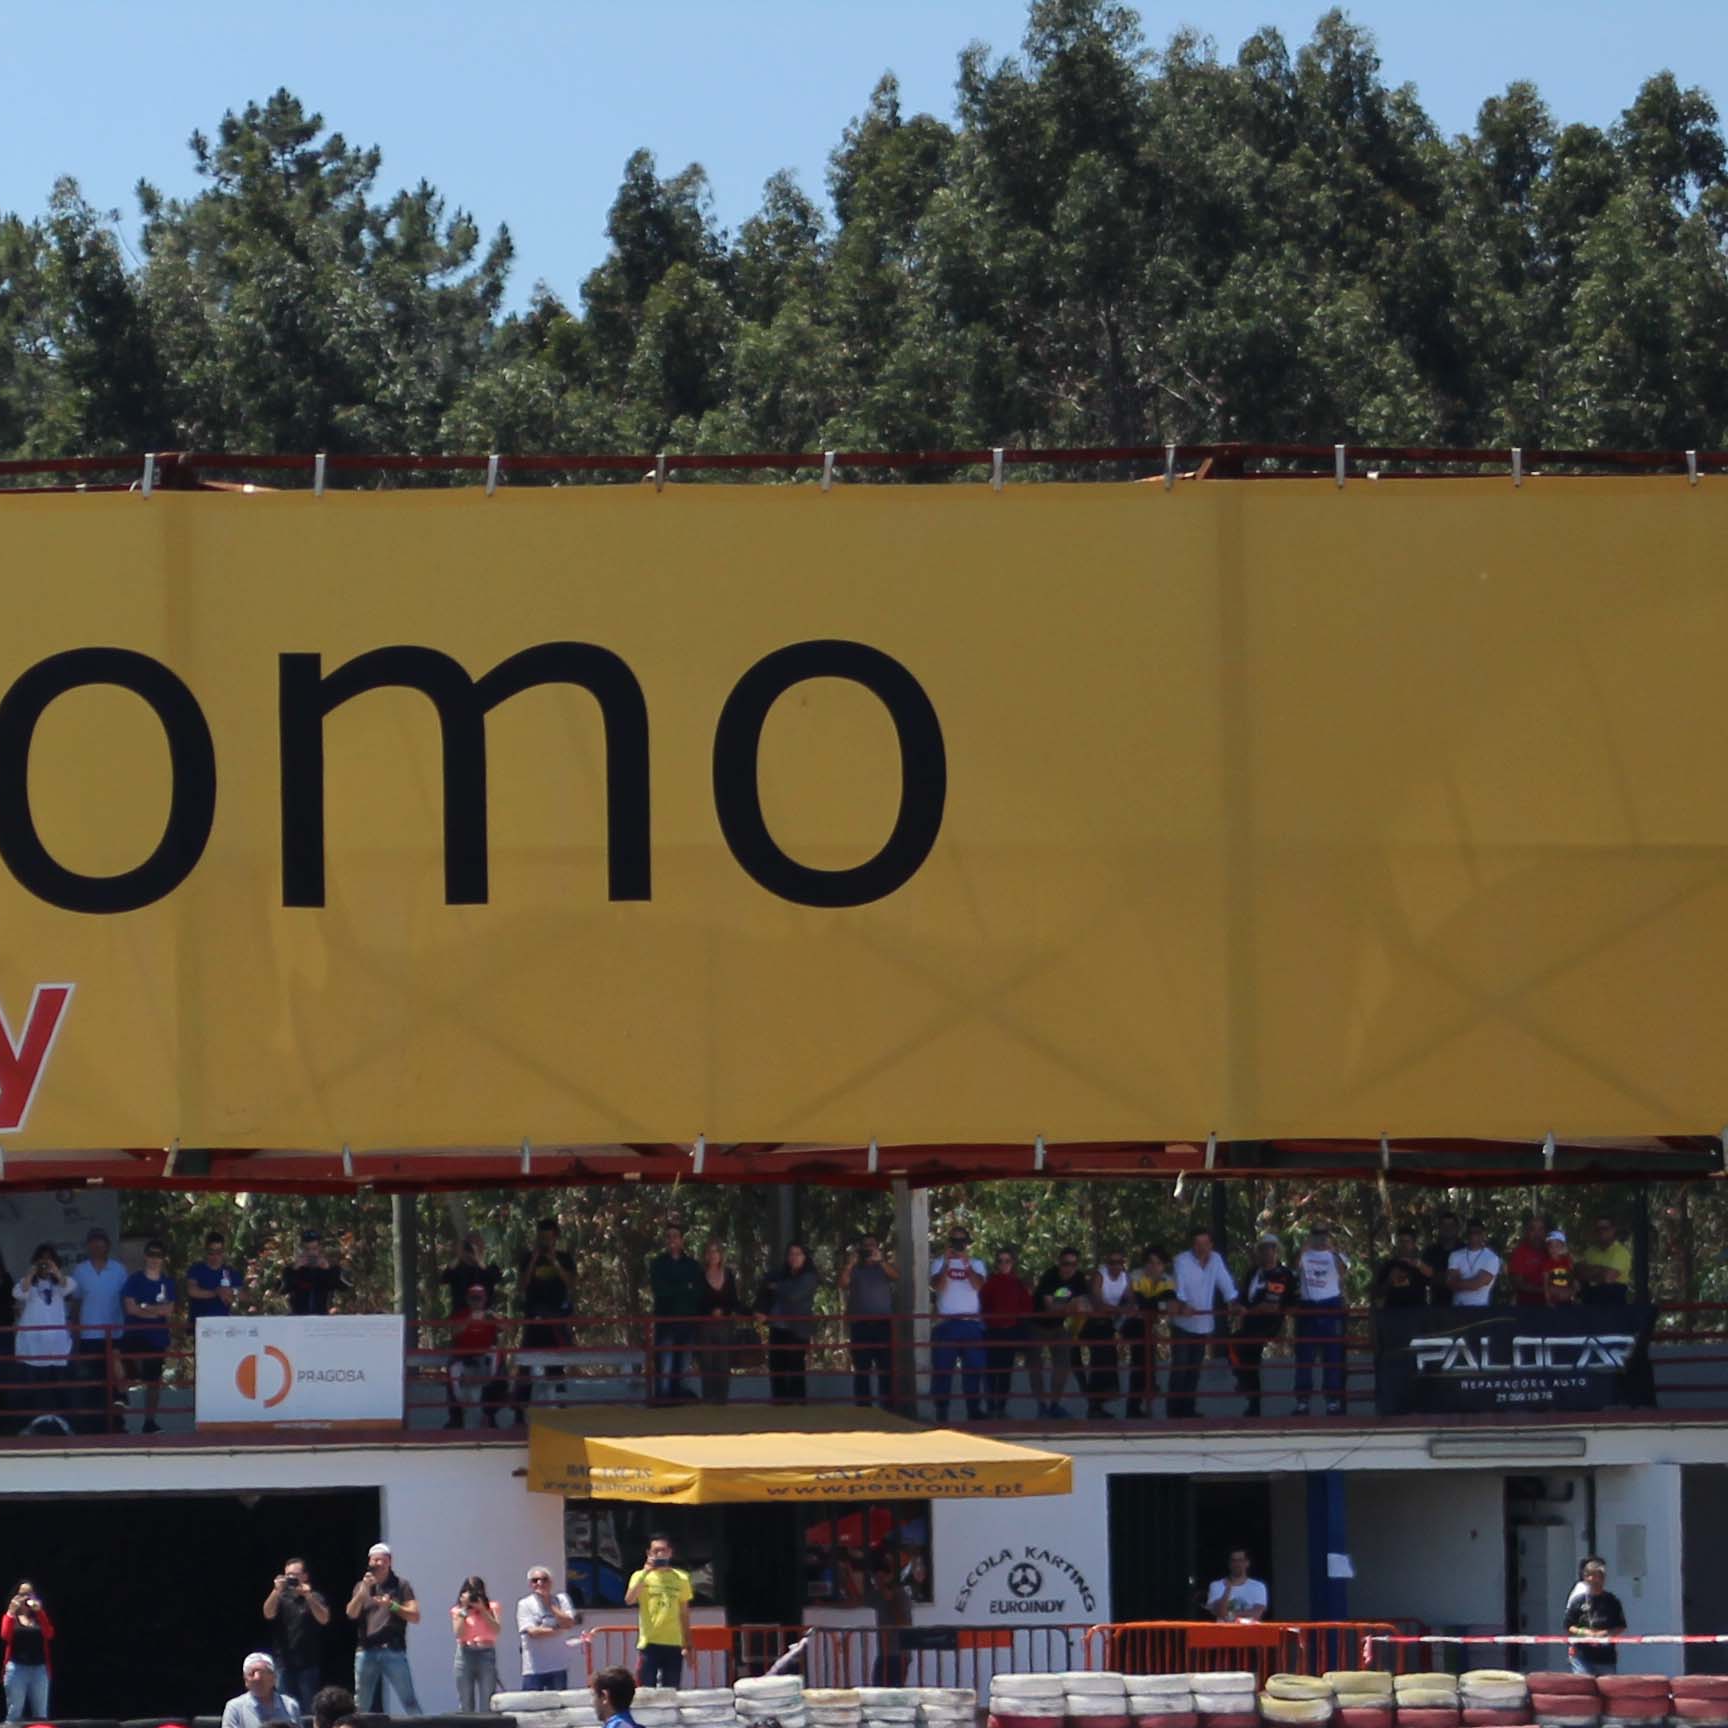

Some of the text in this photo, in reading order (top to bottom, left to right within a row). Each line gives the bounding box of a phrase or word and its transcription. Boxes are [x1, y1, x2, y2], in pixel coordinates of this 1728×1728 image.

[296, 1369, 366, 1383] PRAGOSA
[954, 1546, 1096, 1613] ESCOLA KARTING
[989, 1600, 1065, 1614] EUROINDY
